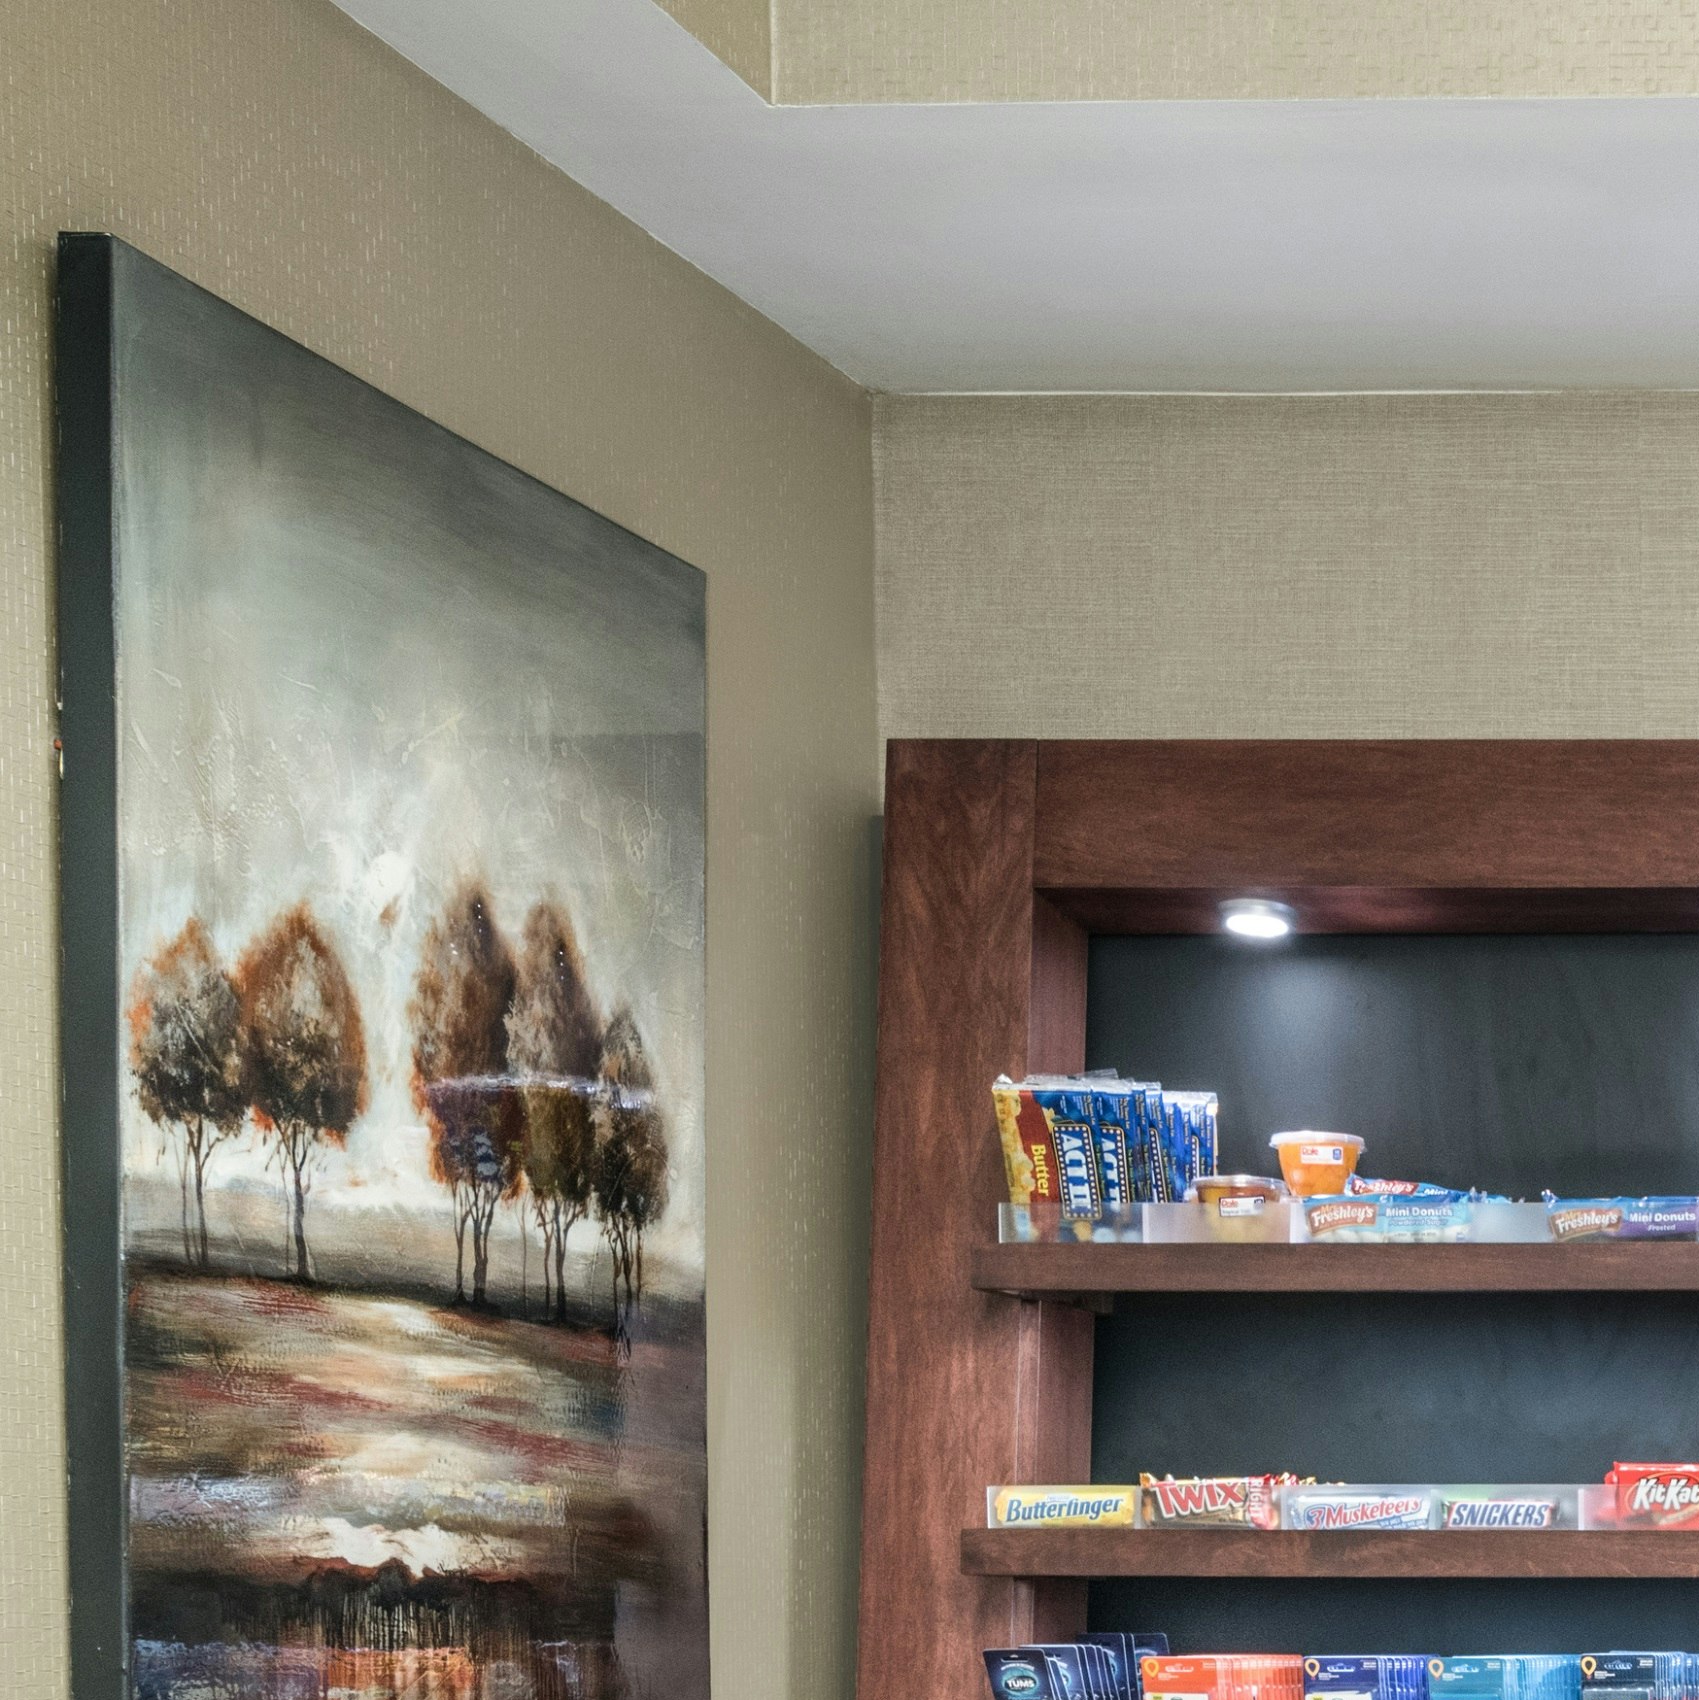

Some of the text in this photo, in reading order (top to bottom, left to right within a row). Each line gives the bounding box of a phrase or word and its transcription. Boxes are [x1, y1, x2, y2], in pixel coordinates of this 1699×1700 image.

[1031, 1144, 1049, 1196] Butter
[1311, 1204, 1374, 1227] Freshley's
[1386, 1207, 1453, 1217] Mini Donuts
[1556, 1211, 1619, 1233] Freshley's
[1629, 1211, 1697, 1223] Mini Donuts
[1006, 1497, 1124, 1522] Butterfinger
[1324, 1497, 1422, 1528] Musketeers
[1451, 1502, 1552, 1527] SNICKERS
[1006, 1677, 1035, 1690] TUMS
